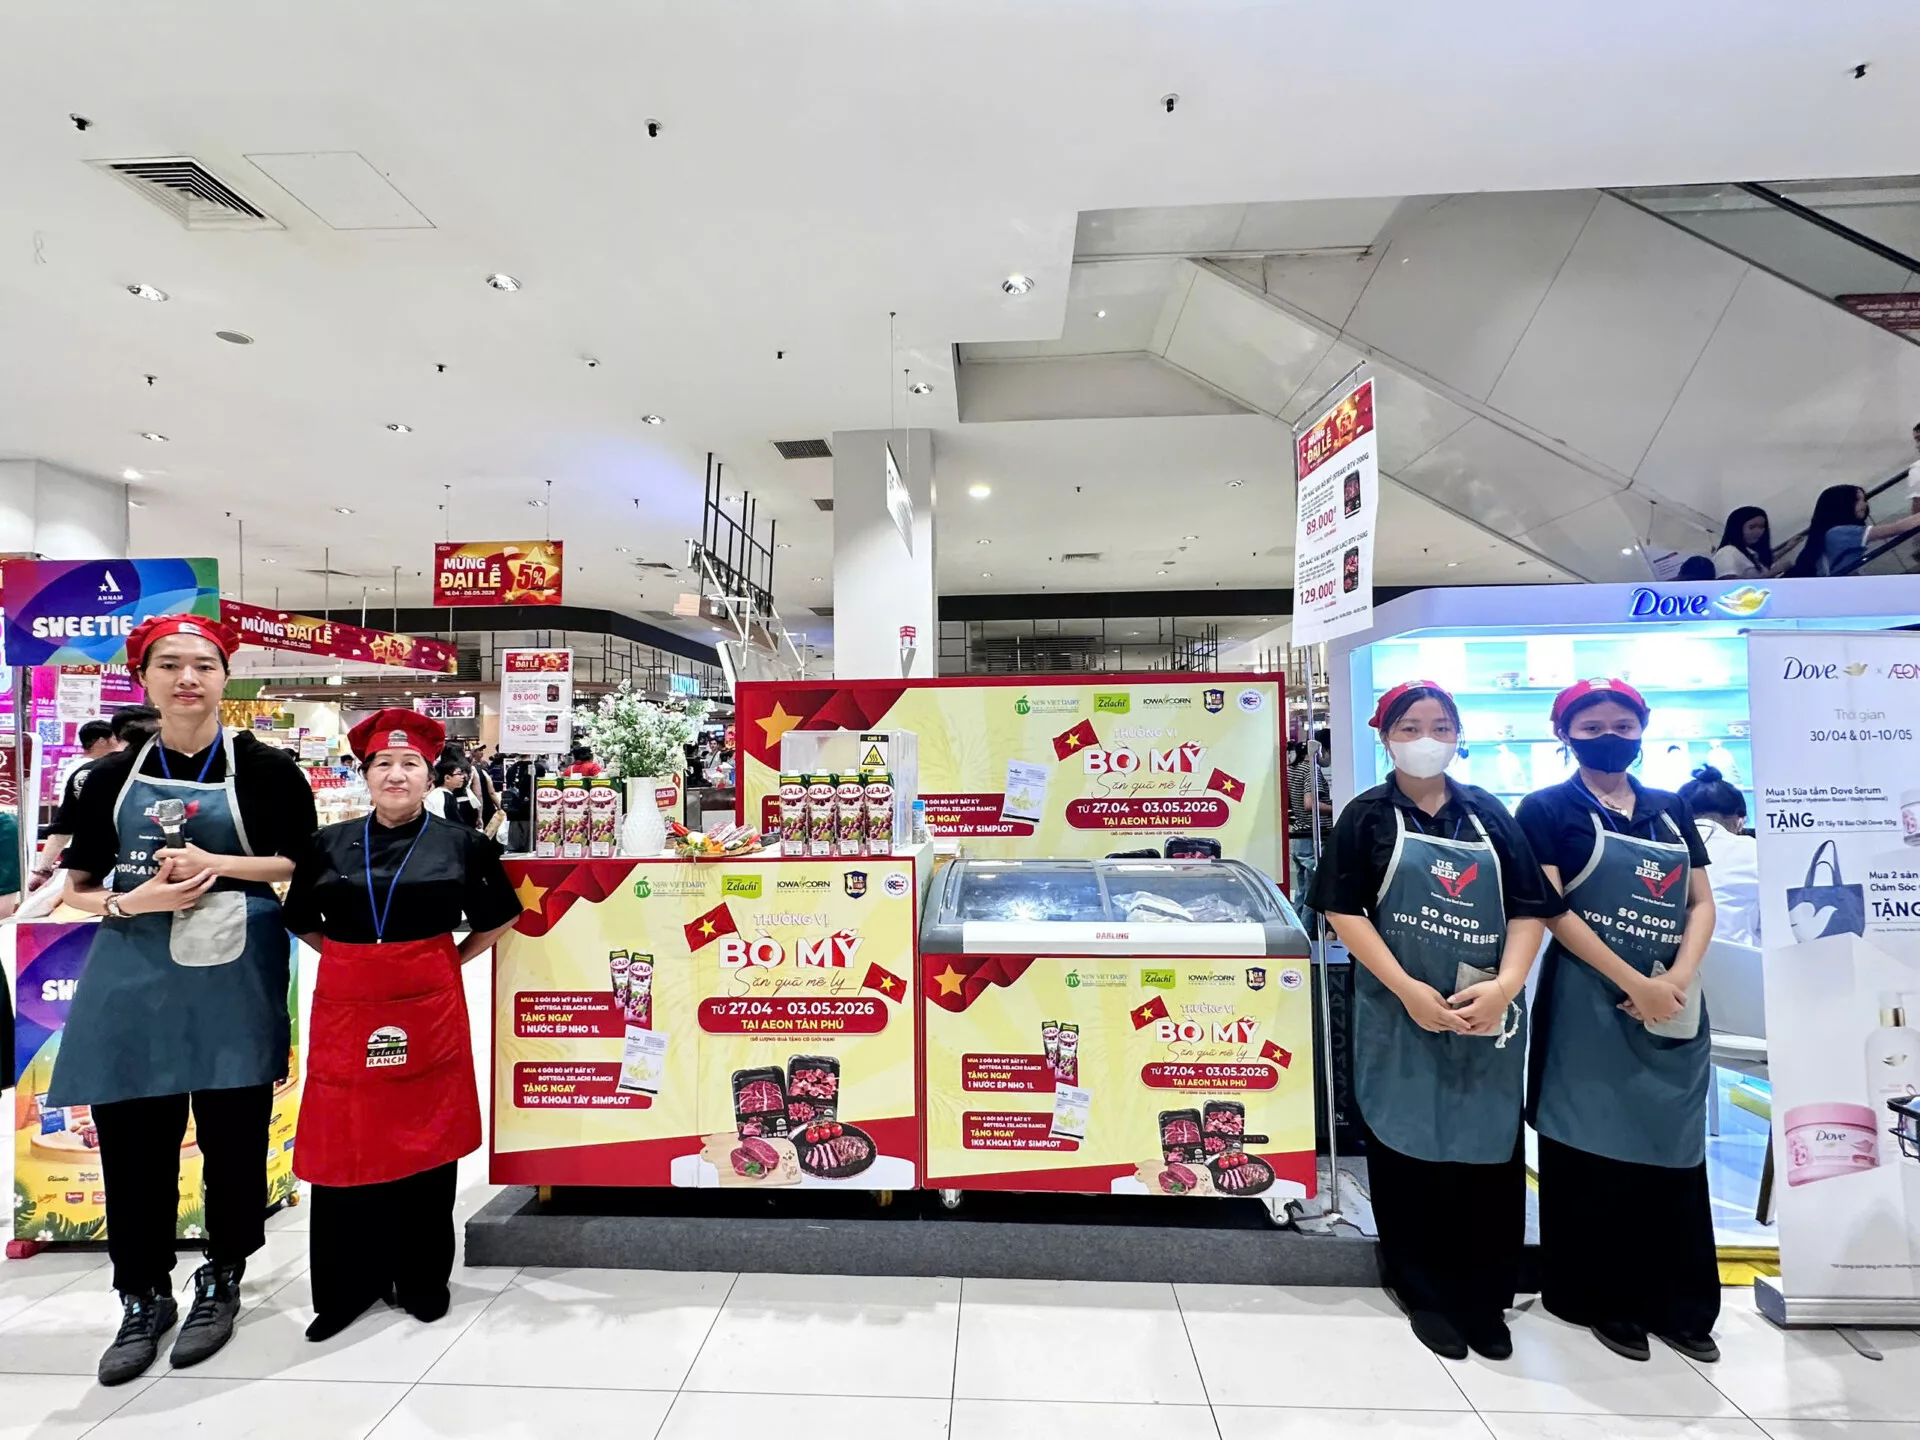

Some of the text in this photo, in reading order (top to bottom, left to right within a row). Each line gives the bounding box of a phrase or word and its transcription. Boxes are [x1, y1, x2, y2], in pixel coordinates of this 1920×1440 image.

[443, 555, 486, 570] MỪNG
[440, 563, 502, 590] ĐẠI LỄ
[1630, 587, 1709, 616] Dove
[241, 615, 332, 645] MỪNG ĐẠI LỄ
[1783, 656, 1838, 679] Dove
[1098, 698, 1126, 708] Zelachi
[1859, 710, 1885, 723] gian
[1810, 730, 1846, 741] 30/04
[1849, 730, 1857, 741] &
[1083, 740, 1208, 774] BÒ MỸ
[1765, 788, 1785, 796] Mua
[1830, 787, 1853, 795] Dove
[1854, 786, 1881, 794] Serum
[1077, 802, 1218, 813] TỪ 27.04 03.05.2026
[937, 815, 961, 823] NGAY
[1103, 815, 1192, 827] TẠI AEON TÂN PHÚ
[1766, 809, 1815, 832] TẶNG
[958, 824, 974, 833] TÂY
[130, 850, 147, 860] SO
[1436, 859, 1455, 871] U.S.
[1642, 858, 1659, 870] U.S.
[1430, 864, 1460, 881] BEEF
[1634, 866, 1666, 881] BEEF
[1869, 871, 1889, 879] Mua
[726, 880, 757, 891] Zelachi
[1898, 882, 1917, 891] Sóc
[754, 911, 829, 927] THƯỞNG VỊ
[1421, 905, 1480, 930] SO GOOD
[1617, 907, 1676, 930] SO GOOD
[1392, 912, 1417, 926] YOU
[1420, 920, 1460, 940] CAN'T
[1583, 909, 1659, 941] YOU CAN'T
[1096, 932, 1130, 940] DARLING
[719, 928, 865, 968] BÒ MỸ
[1145, 973, 1173, 983] Zelachi
[711, 1004, 725, 1014] TỪ
[729, 1002, 773, 1015] 27.04
[787, 1002, 875, 1015] 03.05.2026
[521, 1013, 573, 1024] TẶNG NGAY
[741, 1017, 844, 1031] TẠI AEON TÂN PHÚ
[521, 1023, 600, 1034] 1 NƯỚC ÉP NHO 1L
[1156, 1015, 1261, 1043] BÒ MỸ
[368, 1056, 405, 1066] RANCH
[967, 1071, 989, 1079] TẶNG
[1151, 1066, 1269, 1076] TỪ 27.04 03.05.2026
[997, 1080, 1007, 1088] ÉP
[1008, 1081, 1025, 1089] NHO
[1172, 1077, 1247, 1087] TẠI AEON TÂN PHÚ
[523, 1084, 576, 1094] TẶNG NGAY
[523, 1094, 631, 1105] 1KG KHOAI TÂY SIMPLOT
[970, 1129, 1015, 1138] TẶNG NGAY
[1815, 1129, 1846, 1143] Dove
[1013, 1139, 1027, 1147] TÂY
